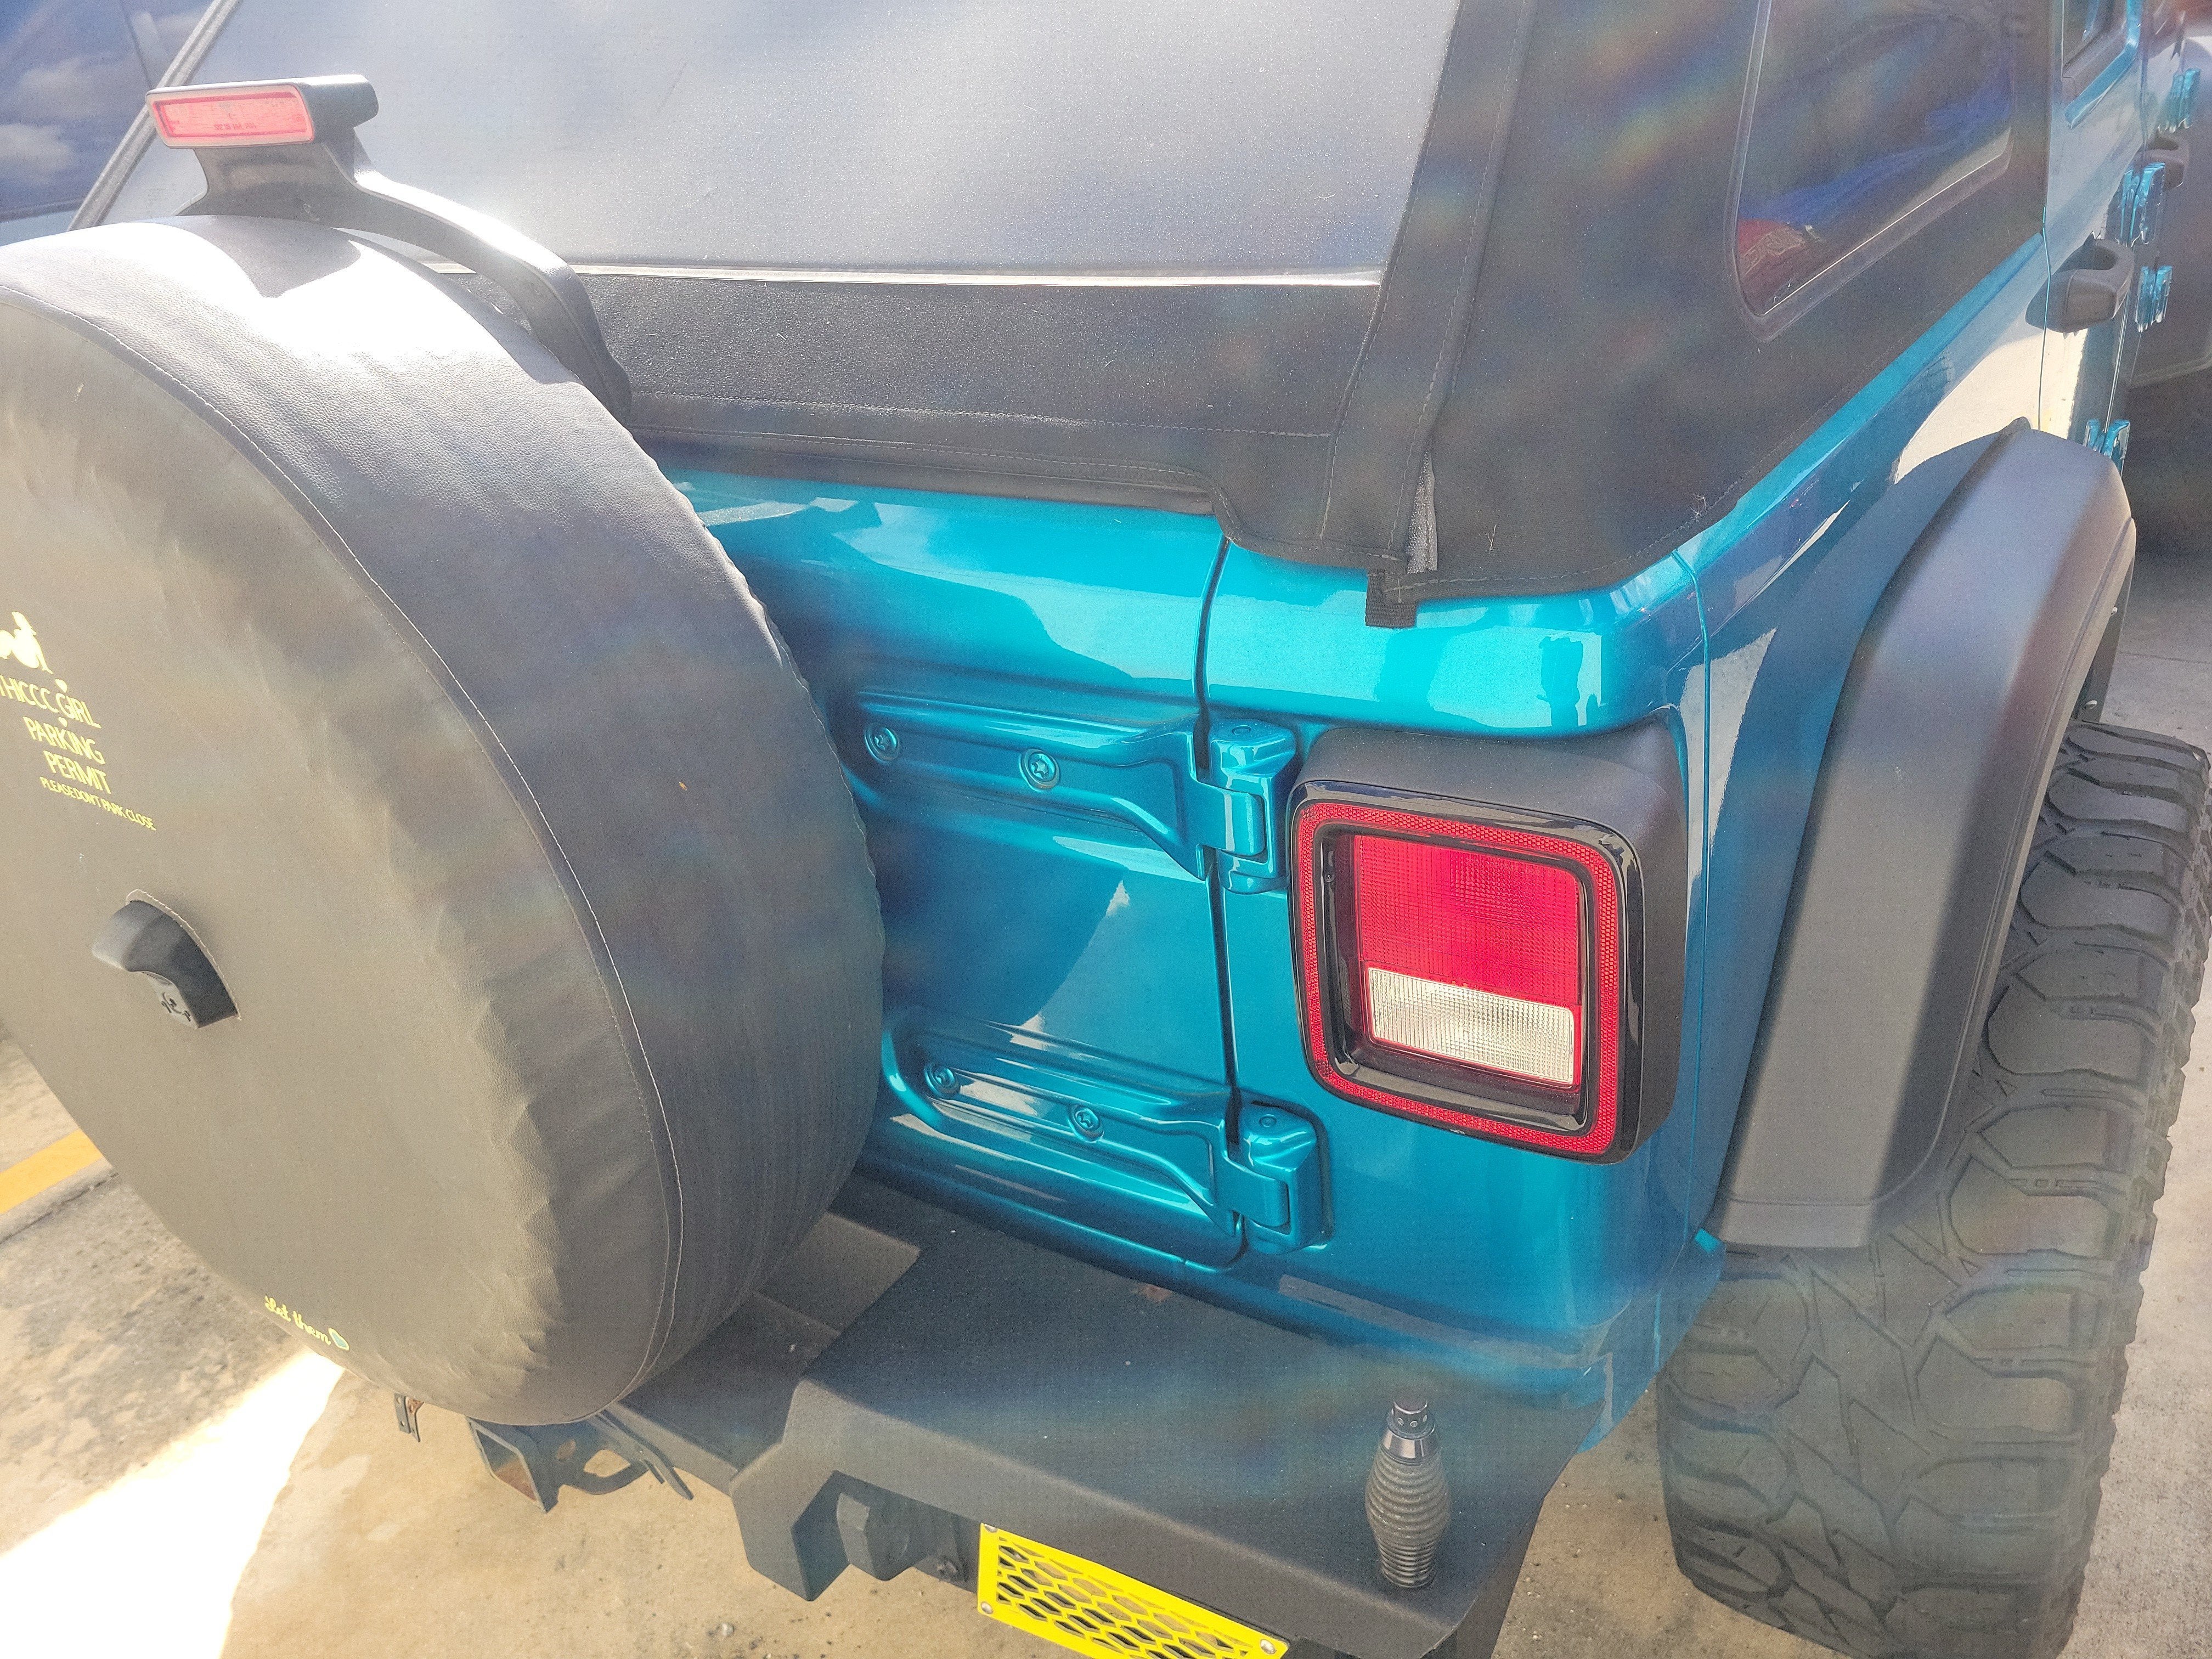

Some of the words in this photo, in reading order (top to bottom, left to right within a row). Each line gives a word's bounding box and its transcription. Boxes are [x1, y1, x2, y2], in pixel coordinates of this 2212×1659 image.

[56, 693, 101, 729] GIRL
[23, 716, 106, 765] PARKING
[43, 751, 111, 794] PERMIT
[100, 798, 127, 819] PARK
[125, 808, 157, 831] CLOSE
[293, 1311, 331, 1345] them
